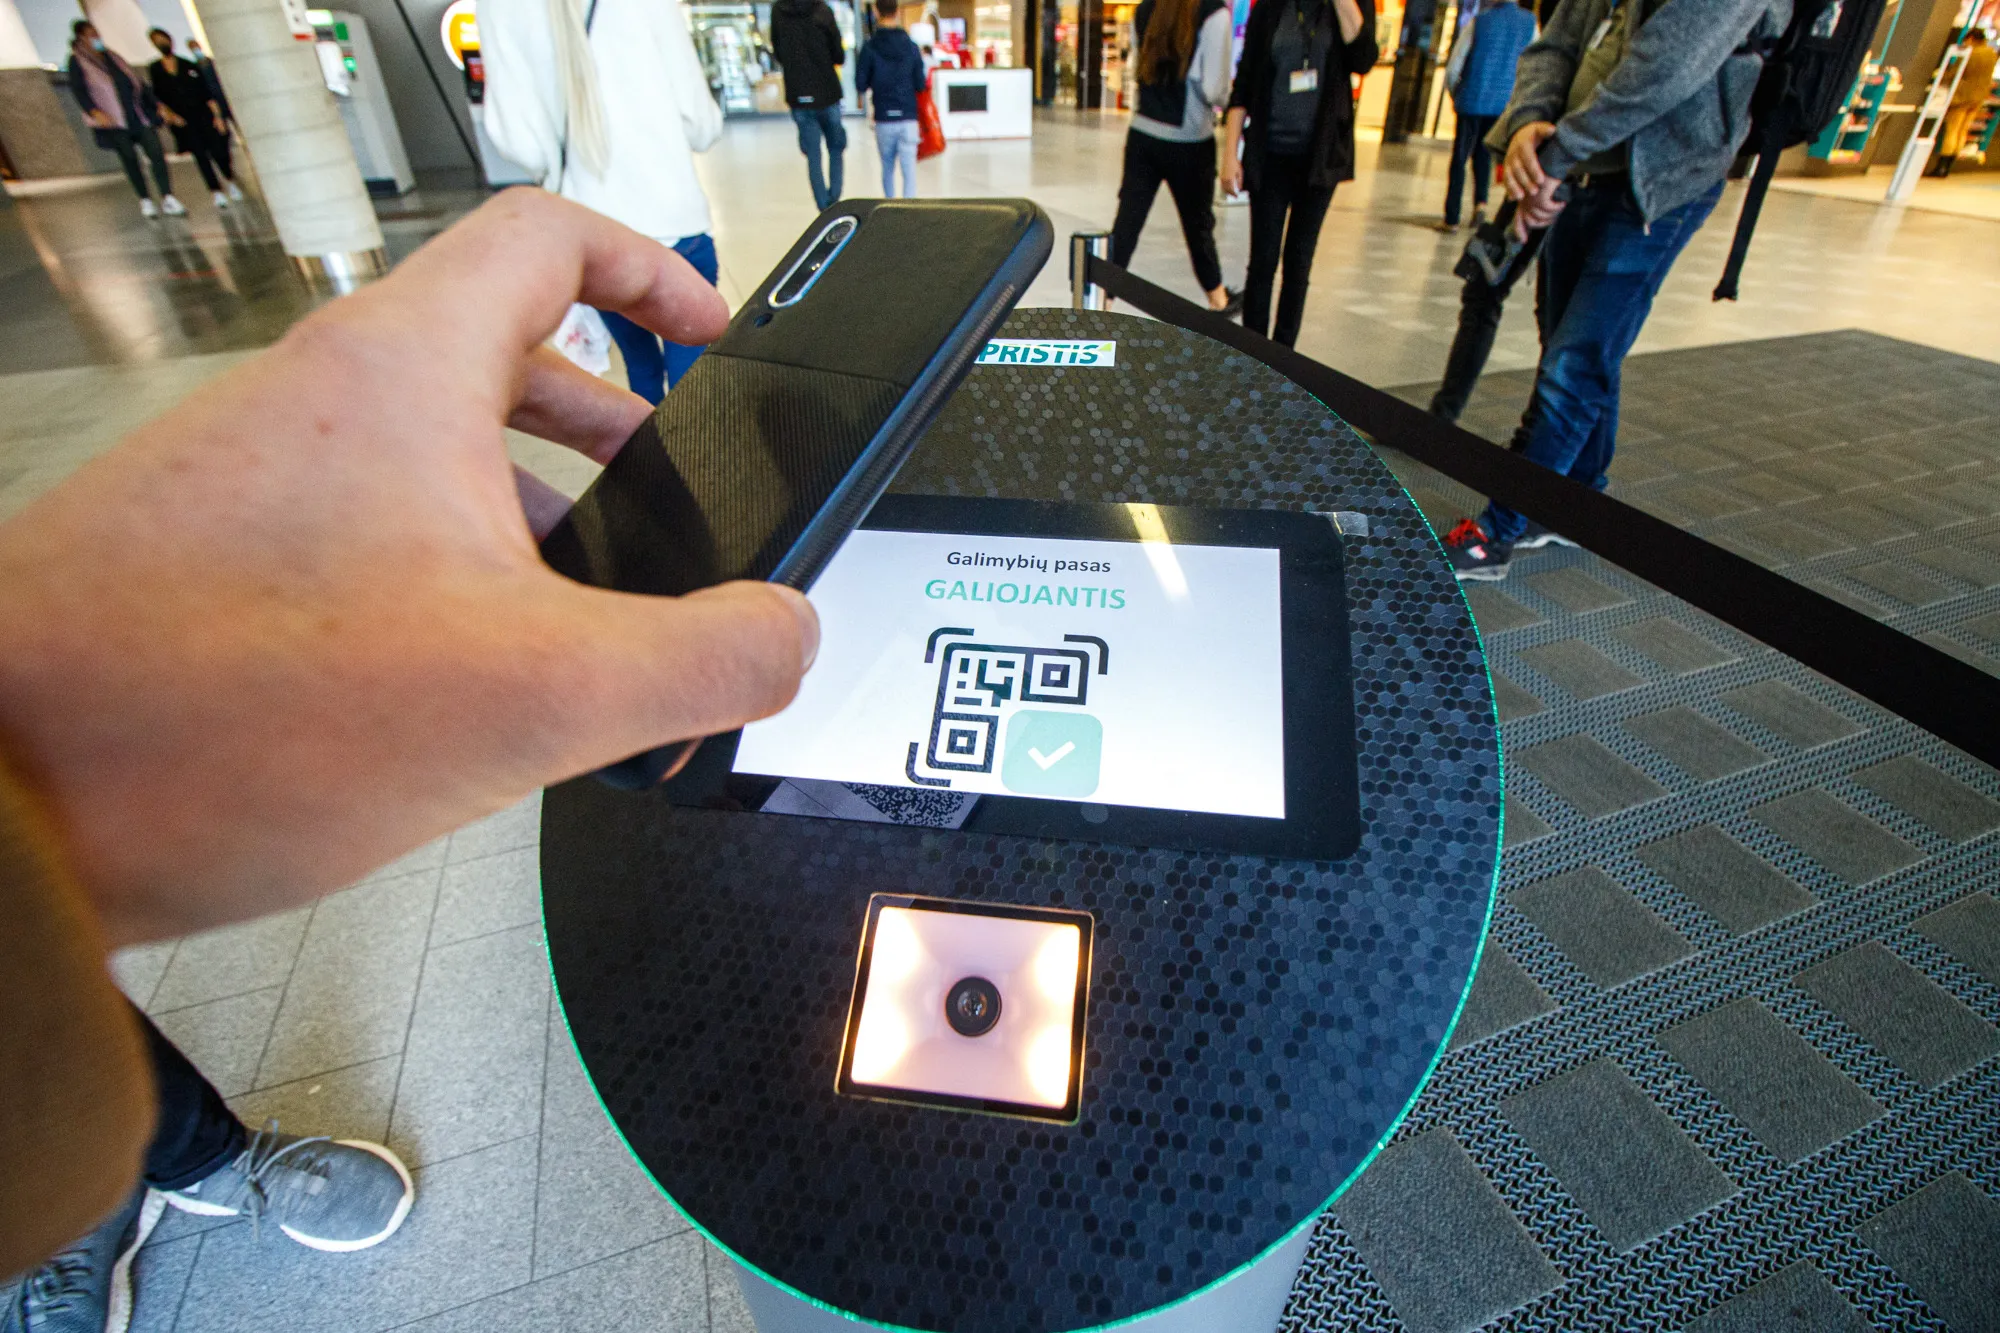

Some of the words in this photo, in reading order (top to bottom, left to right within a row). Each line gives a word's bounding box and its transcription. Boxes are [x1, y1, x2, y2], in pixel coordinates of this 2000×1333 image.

[946, 551, 1048, 573] Galimybių
[1054, 558, 1111, 573] pasas
[925, 579, 1126, 609] GALIOJANTIS
